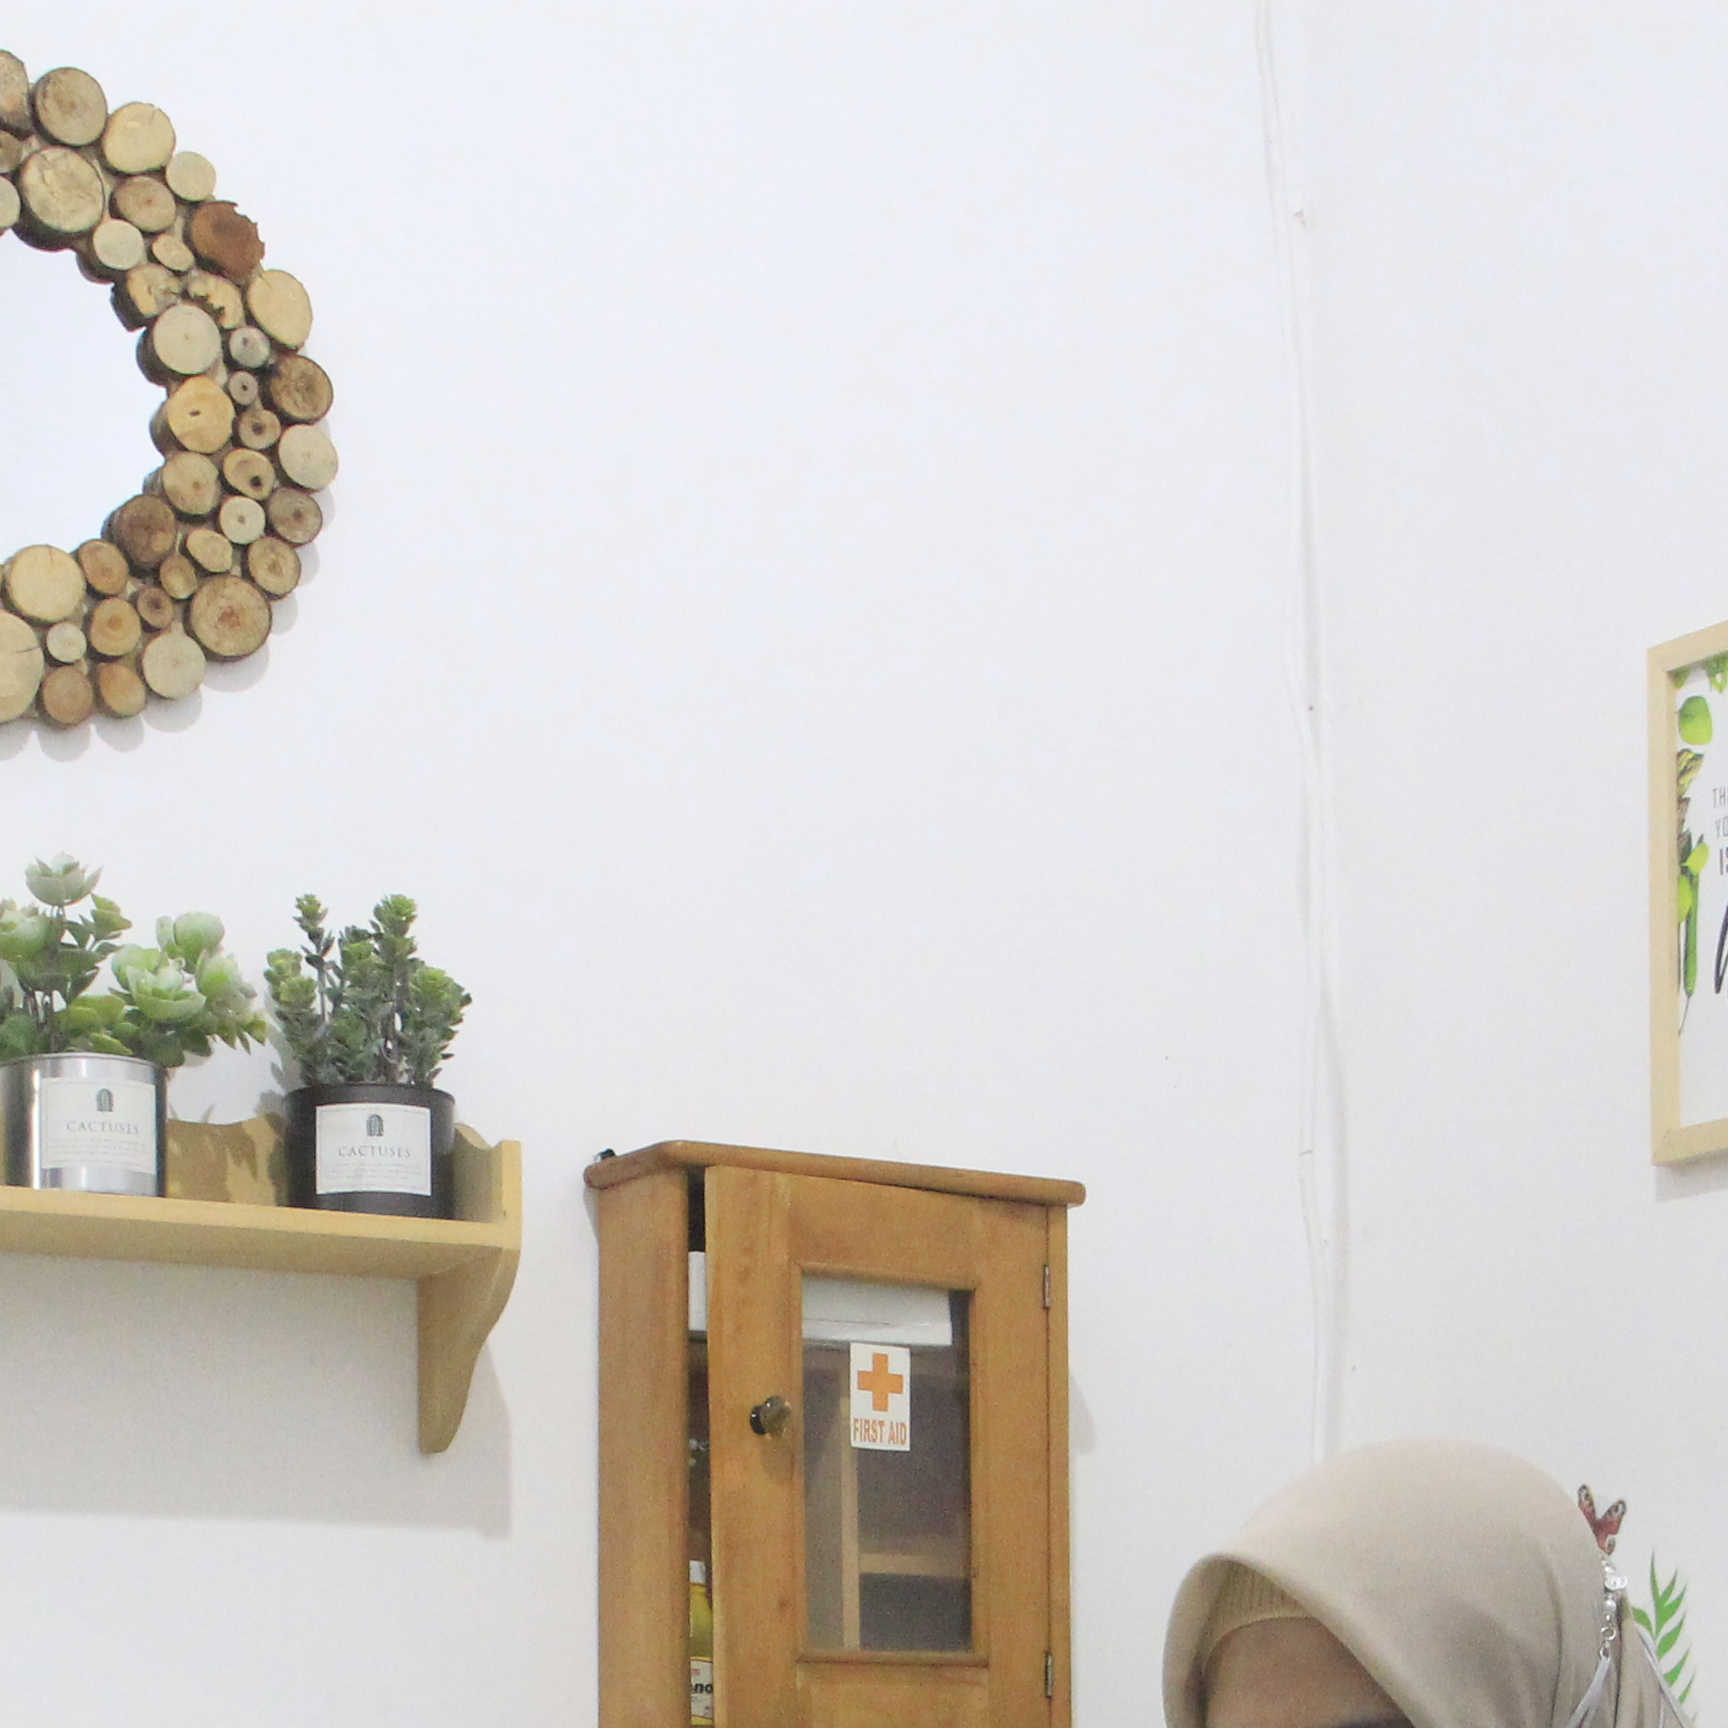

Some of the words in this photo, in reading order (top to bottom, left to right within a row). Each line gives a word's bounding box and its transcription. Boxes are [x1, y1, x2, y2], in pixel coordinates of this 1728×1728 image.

[66, 1120, 140, 1135] CACTUSES
[338, 1145, 411, 1158] CACTUSES
[853, 1418, 885, 1444] FIRST
[888, 1421, 907, 1446] AID
